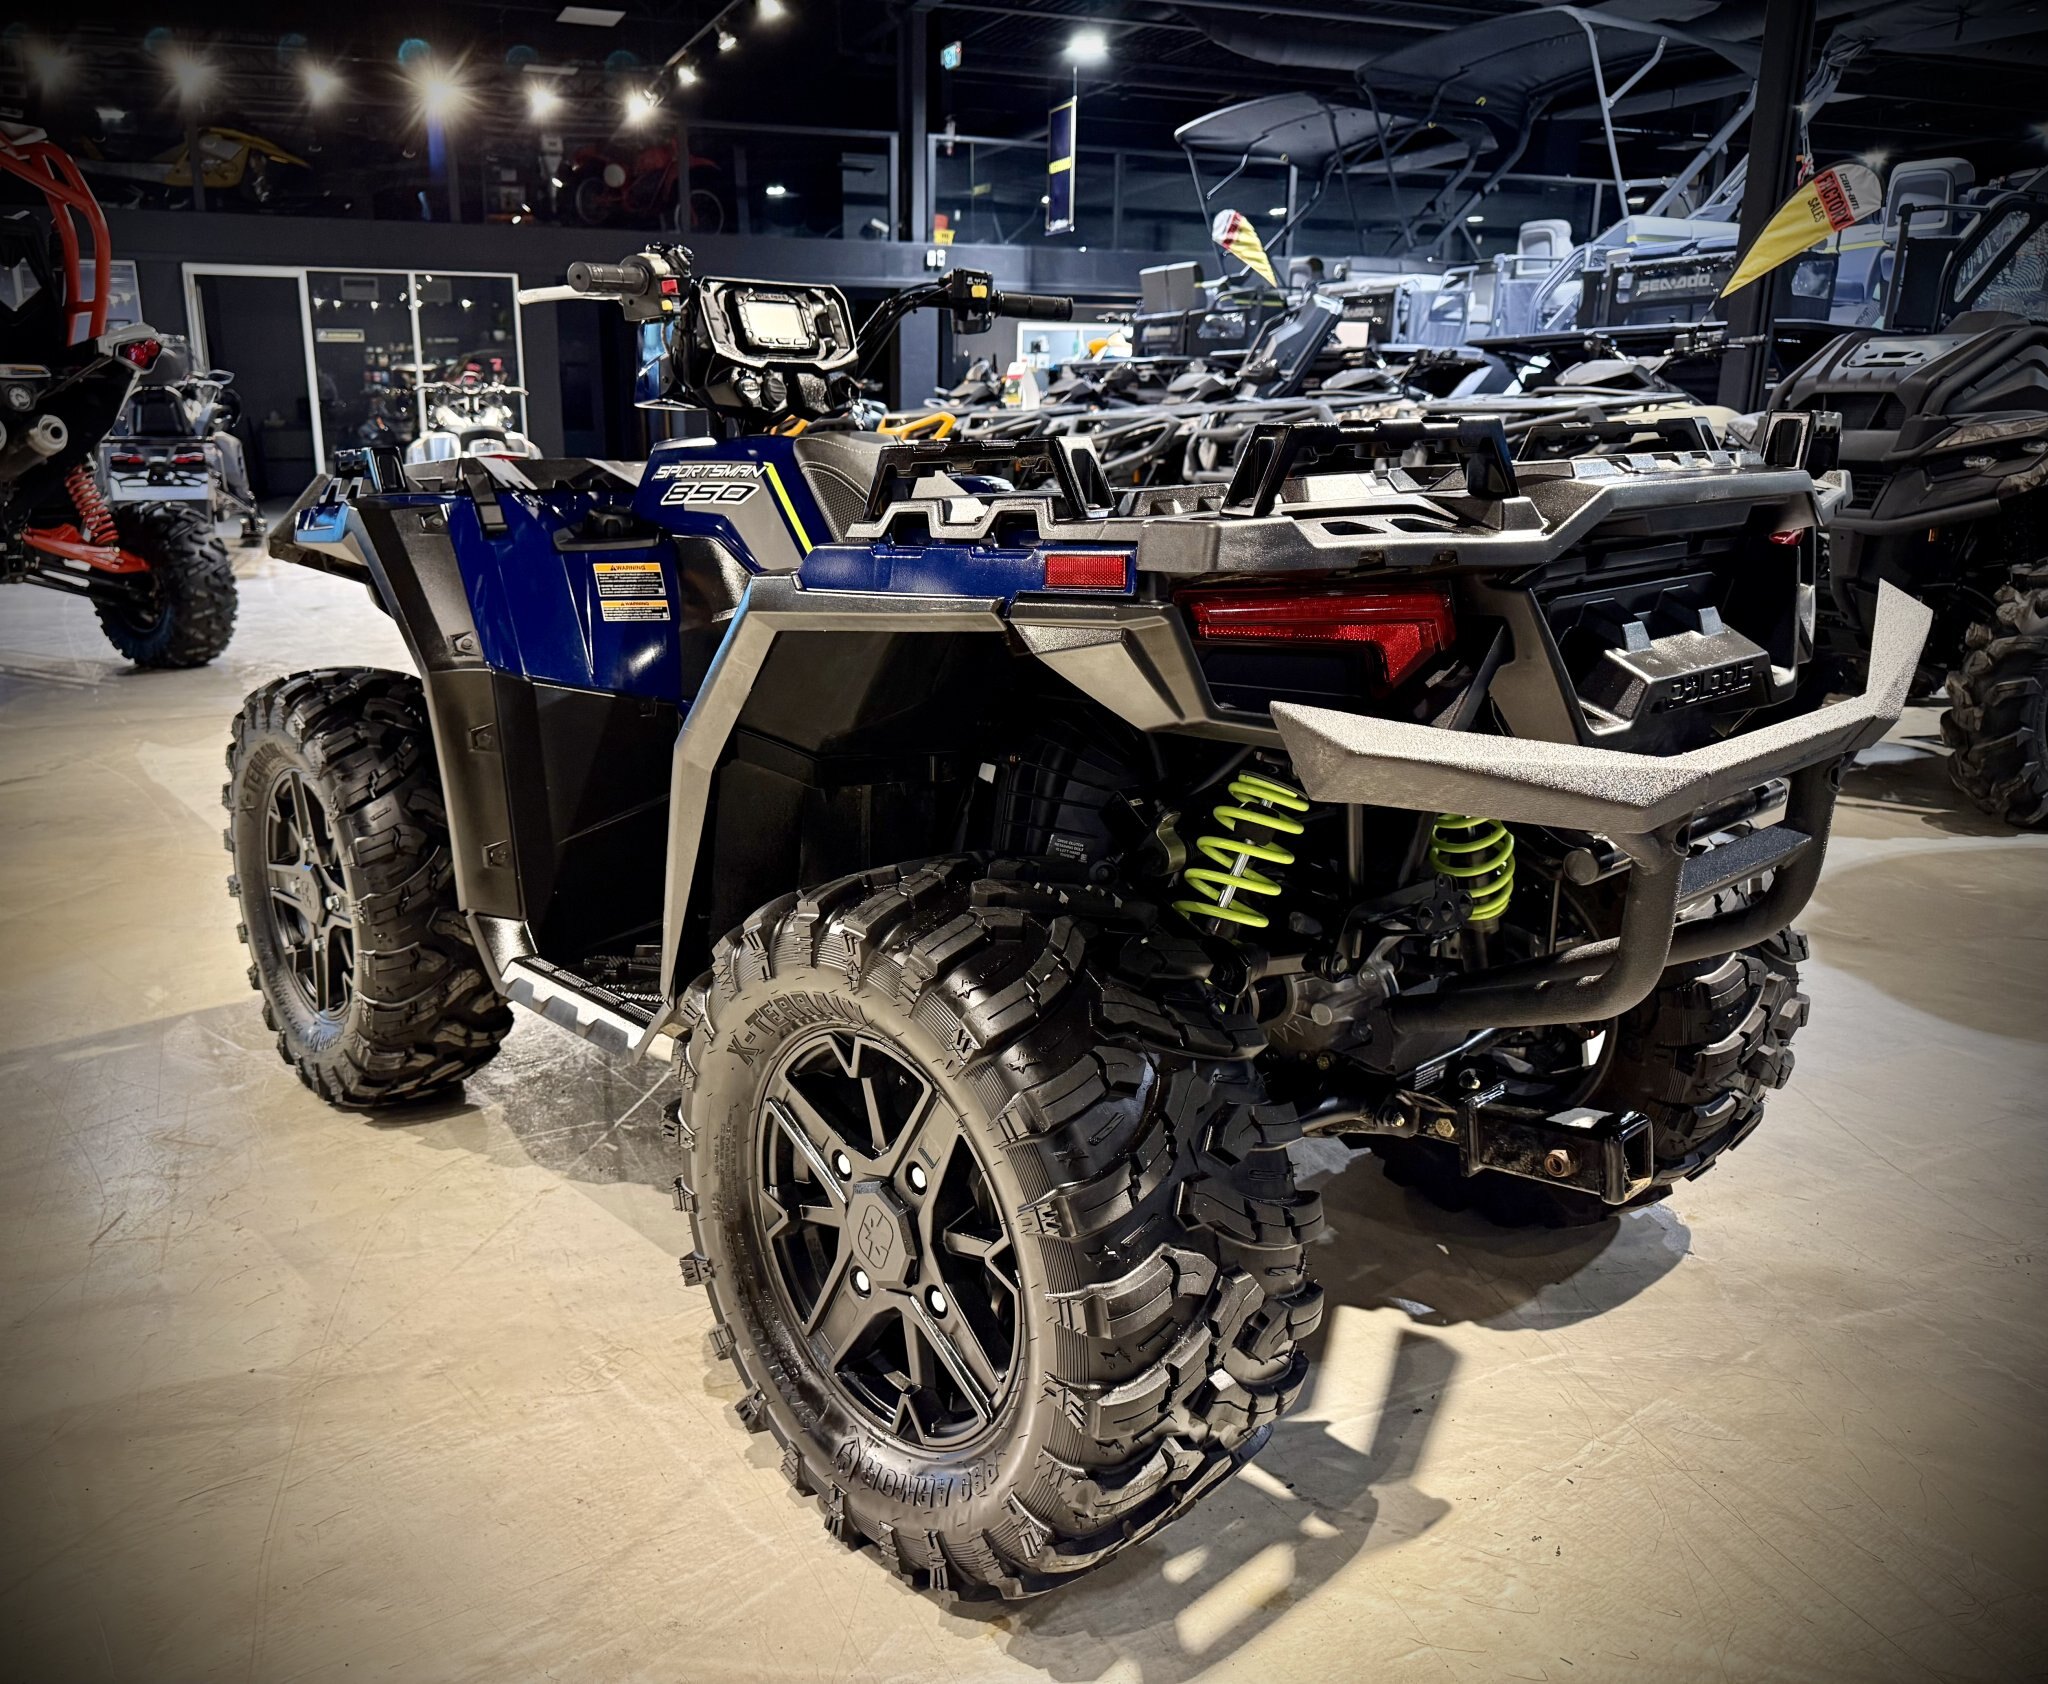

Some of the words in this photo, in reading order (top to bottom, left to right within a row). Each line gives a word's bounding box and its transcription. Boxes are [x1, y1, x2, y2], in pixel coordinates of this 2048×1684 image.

[1808, 197, 1825, 222] SALES
[1817, 173, 1851, 225] FACTORY
[651, 464, 768, 481] SPORTSMAN
[660, 482, 760, 506] 850
